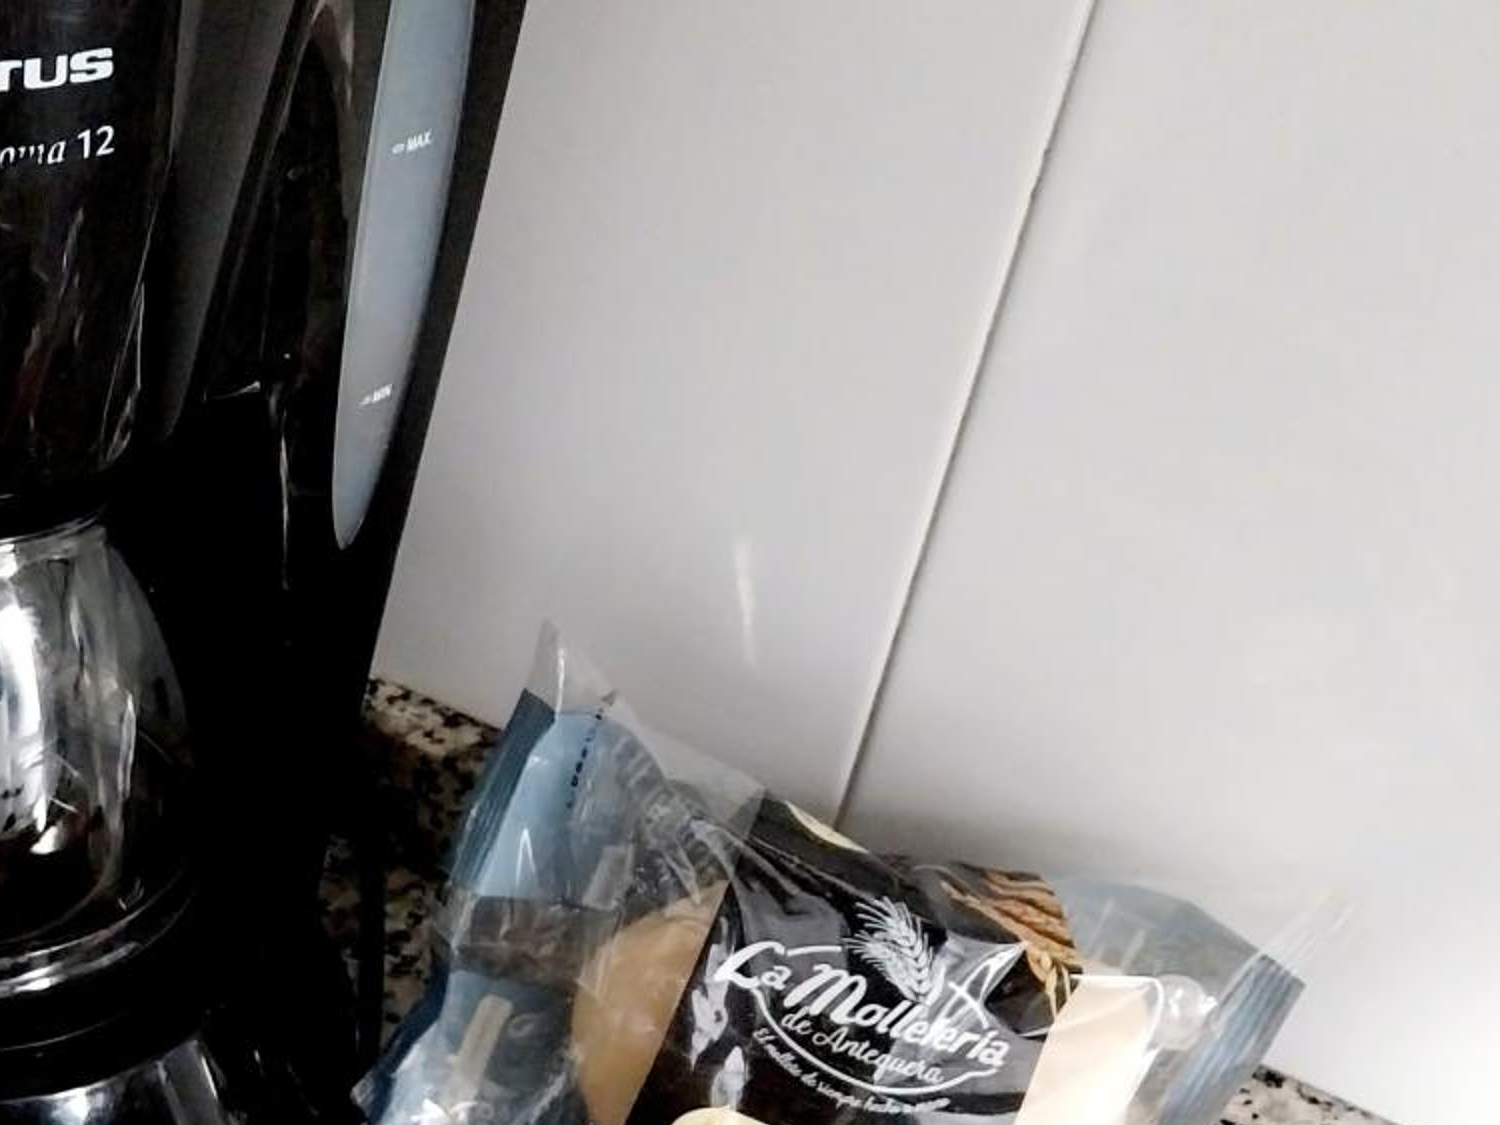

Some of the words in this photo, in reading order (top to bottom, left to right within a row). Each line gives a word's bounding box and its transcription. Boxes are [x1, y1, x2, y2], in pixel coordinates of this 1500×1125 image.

[76, 124, 116, 160] 12
[713, 940, 793, 990] La
[781, 1008, 814, 1036] de
